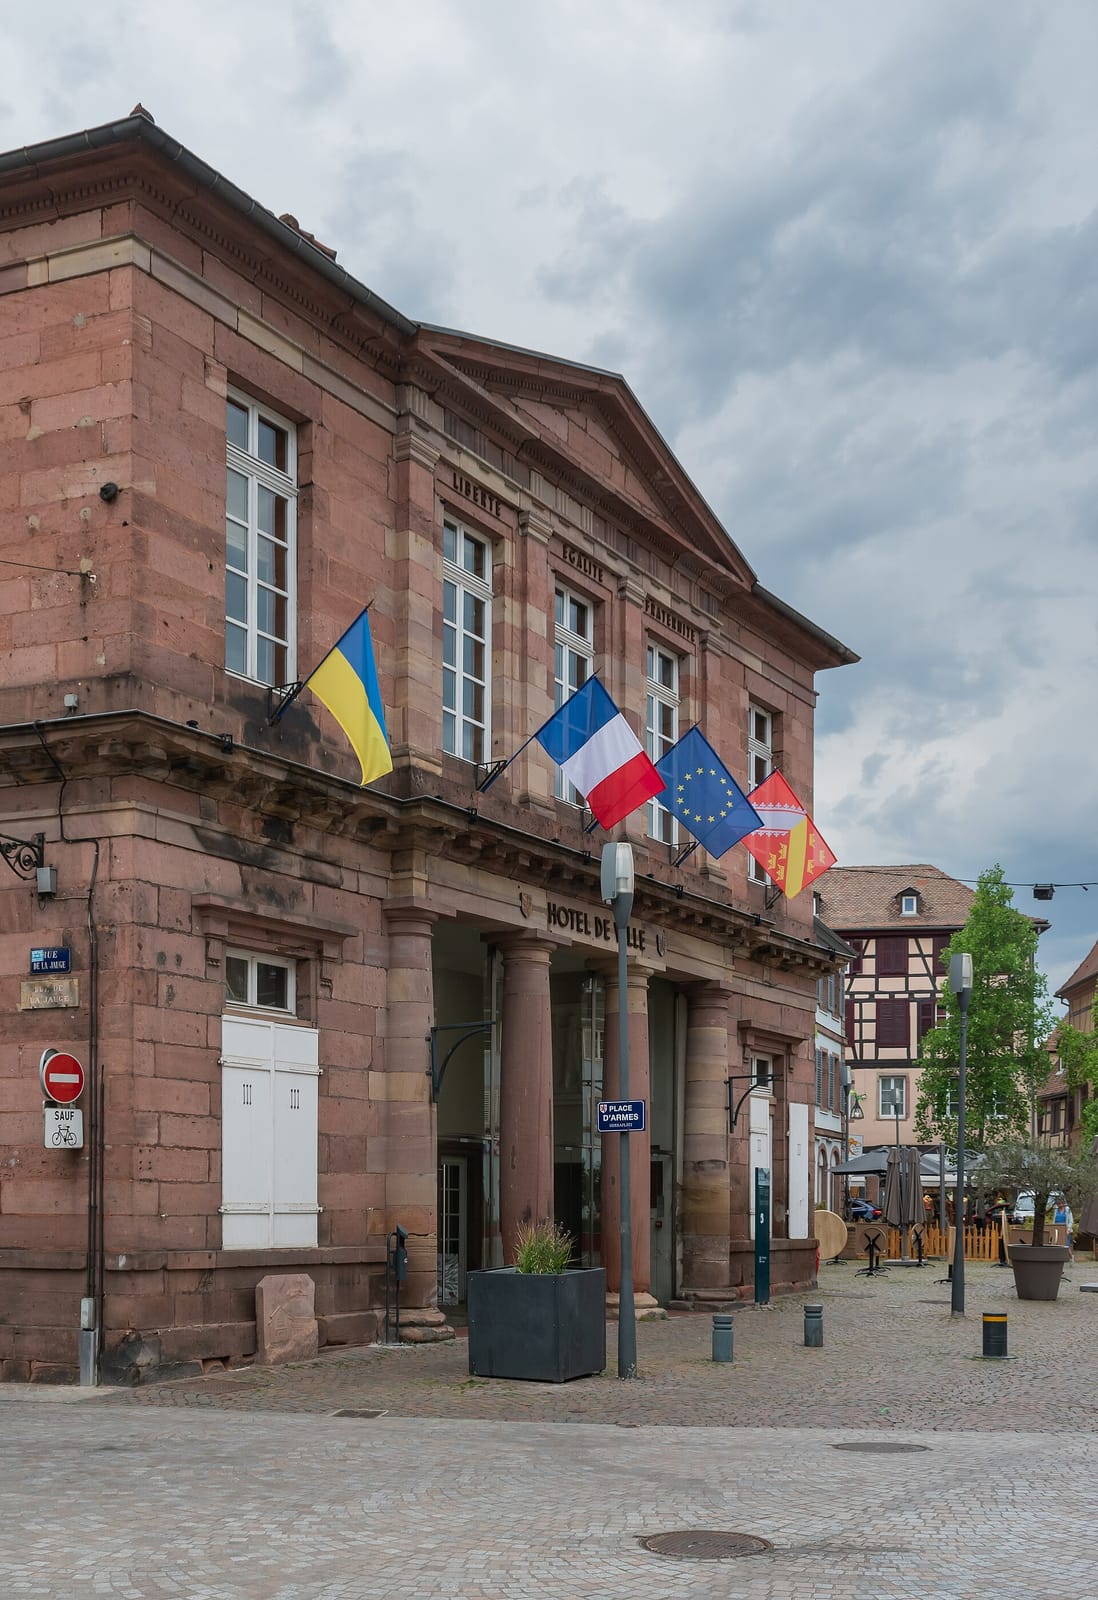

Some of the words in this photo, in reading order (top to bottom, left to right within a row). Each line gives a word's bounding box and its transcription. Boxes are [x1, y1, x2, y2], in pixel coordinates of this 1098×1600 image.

[547, 902, 591, 935] HOTEL
[594, 916, 611, 941] DE
[613, 922, 646, 951] VLLE
[33, 962, 41, 970] DE
[41, 961, 48, 970] LA
[54, 1110, 75, 1121] SAUF
[602, 1113, 639, 1122] D'ARMES
